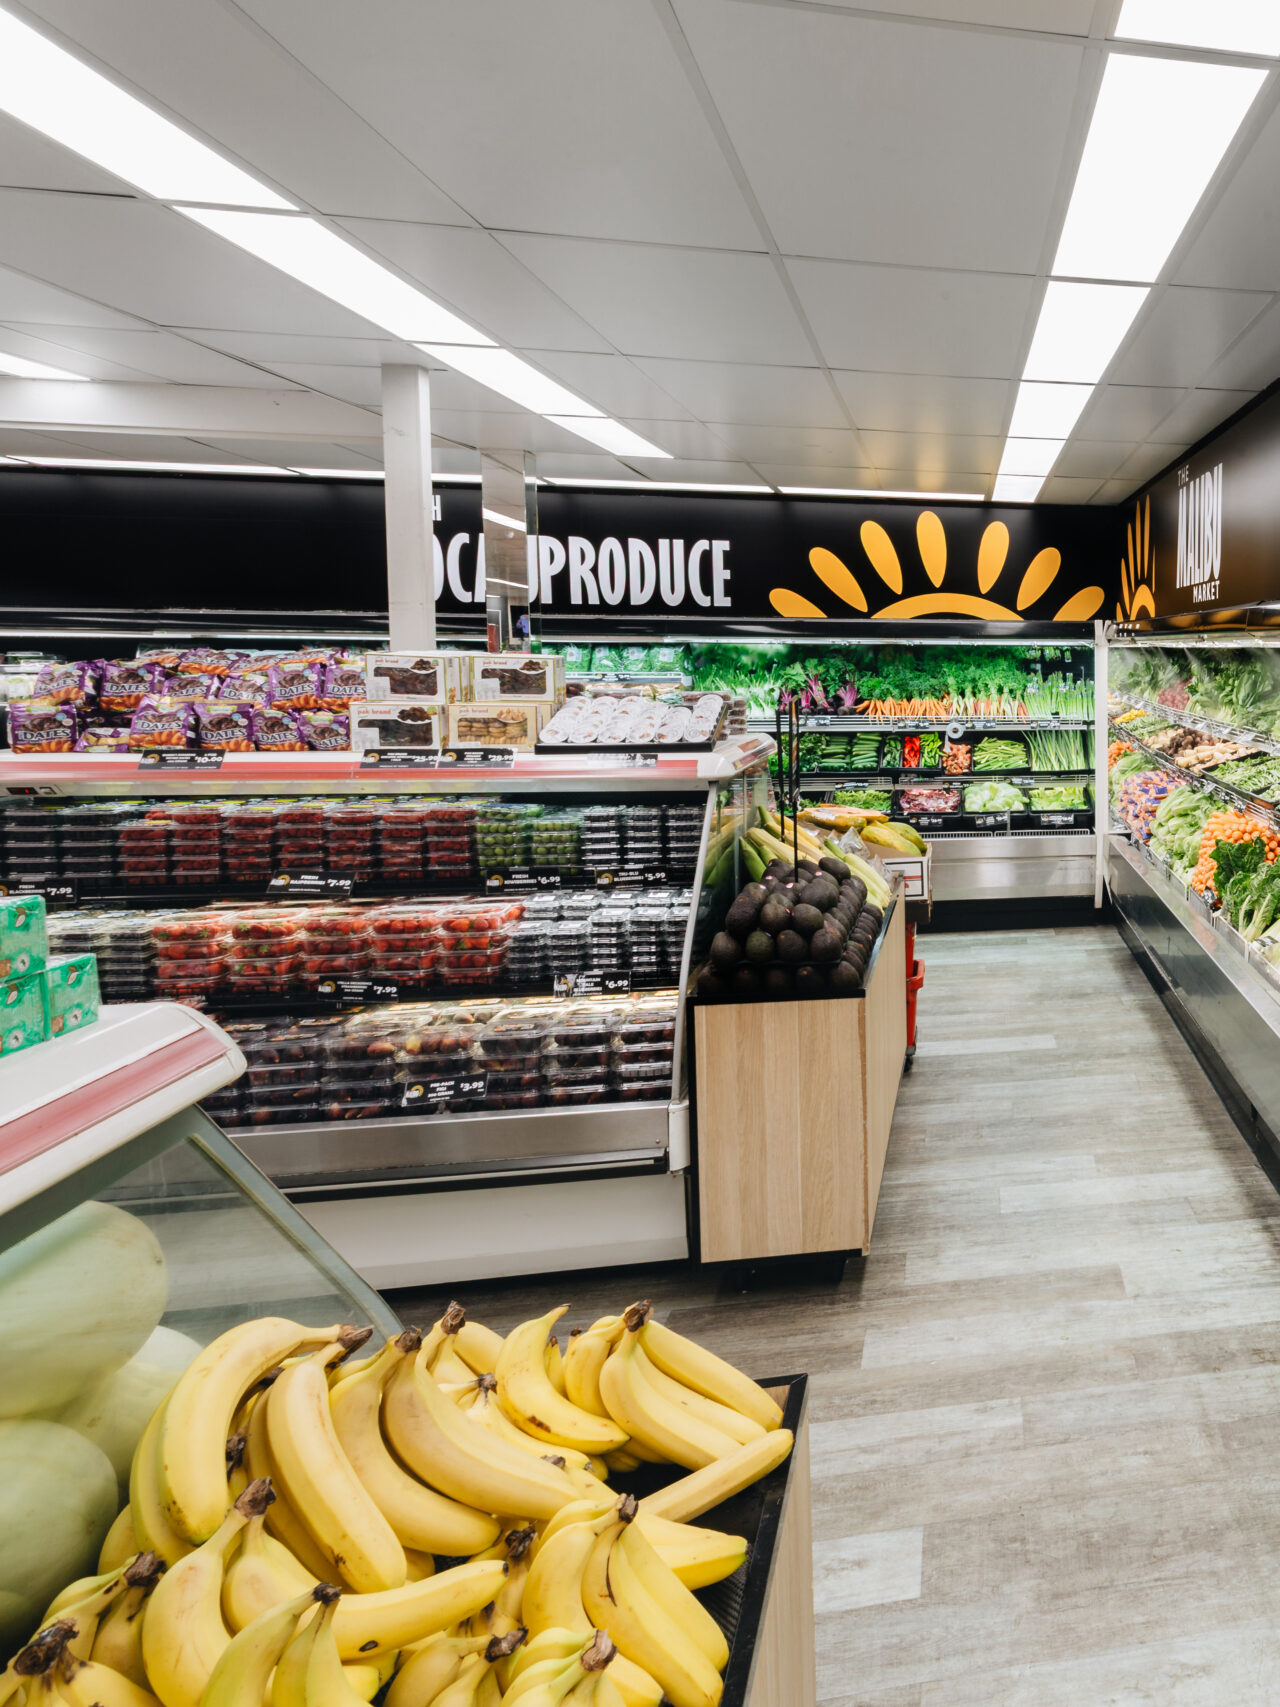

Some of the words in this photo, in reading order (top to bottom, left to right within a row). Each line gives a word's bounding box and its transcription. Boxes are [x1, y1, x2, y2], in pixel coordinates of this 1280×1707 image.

[1178, 464, 1190, 486] THE
[1176, 462, 1223, 589] MALIBU
[538, 535, 732, 607] PRODUCE
[1193, 580, 1220, 604] MARKET
[279, 683, 315, 695] DATES
[23, 729, 71, 740] DATES
[204, 728, 247, 740] DATES
[261, 731, 298, 742] DATES
[538, 876, 560, 884] $6.99
[47, 887, 72, 895] $7.99
[373, 985, 397, 994] $7.99
[606, 980, 628, 989] $6.99
[460, 1081, 484, 1091] $3.99
